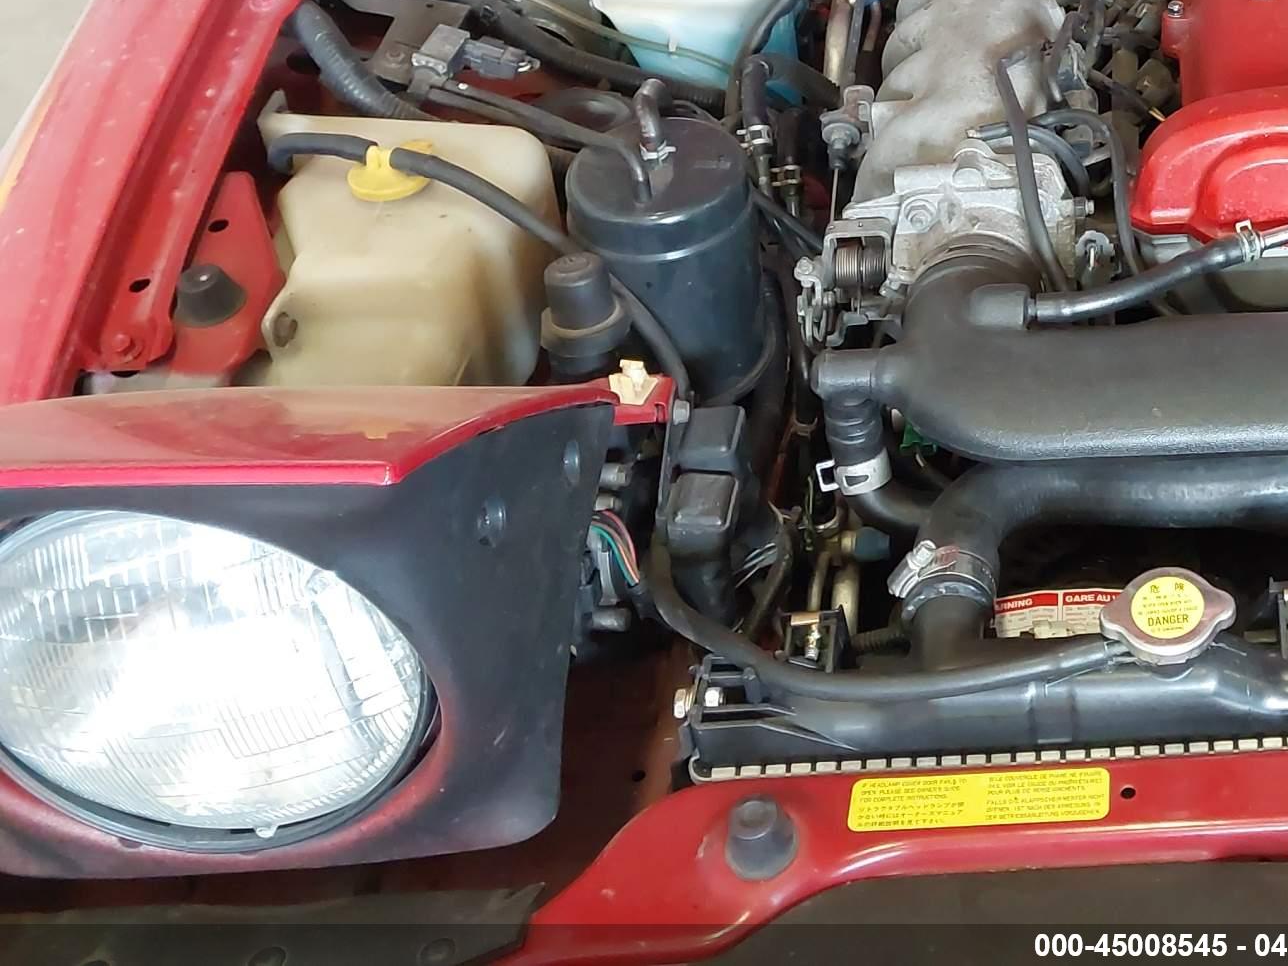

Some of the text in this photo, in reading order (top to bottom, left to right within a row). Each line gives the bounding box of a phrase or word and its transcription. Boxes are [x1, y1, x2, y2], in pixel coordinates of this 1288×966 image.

[1065, 594, 1095, 602] GARE
[1096, 594, 1110, 602] AU
[1148, 614, 1189, 626] DANGER
